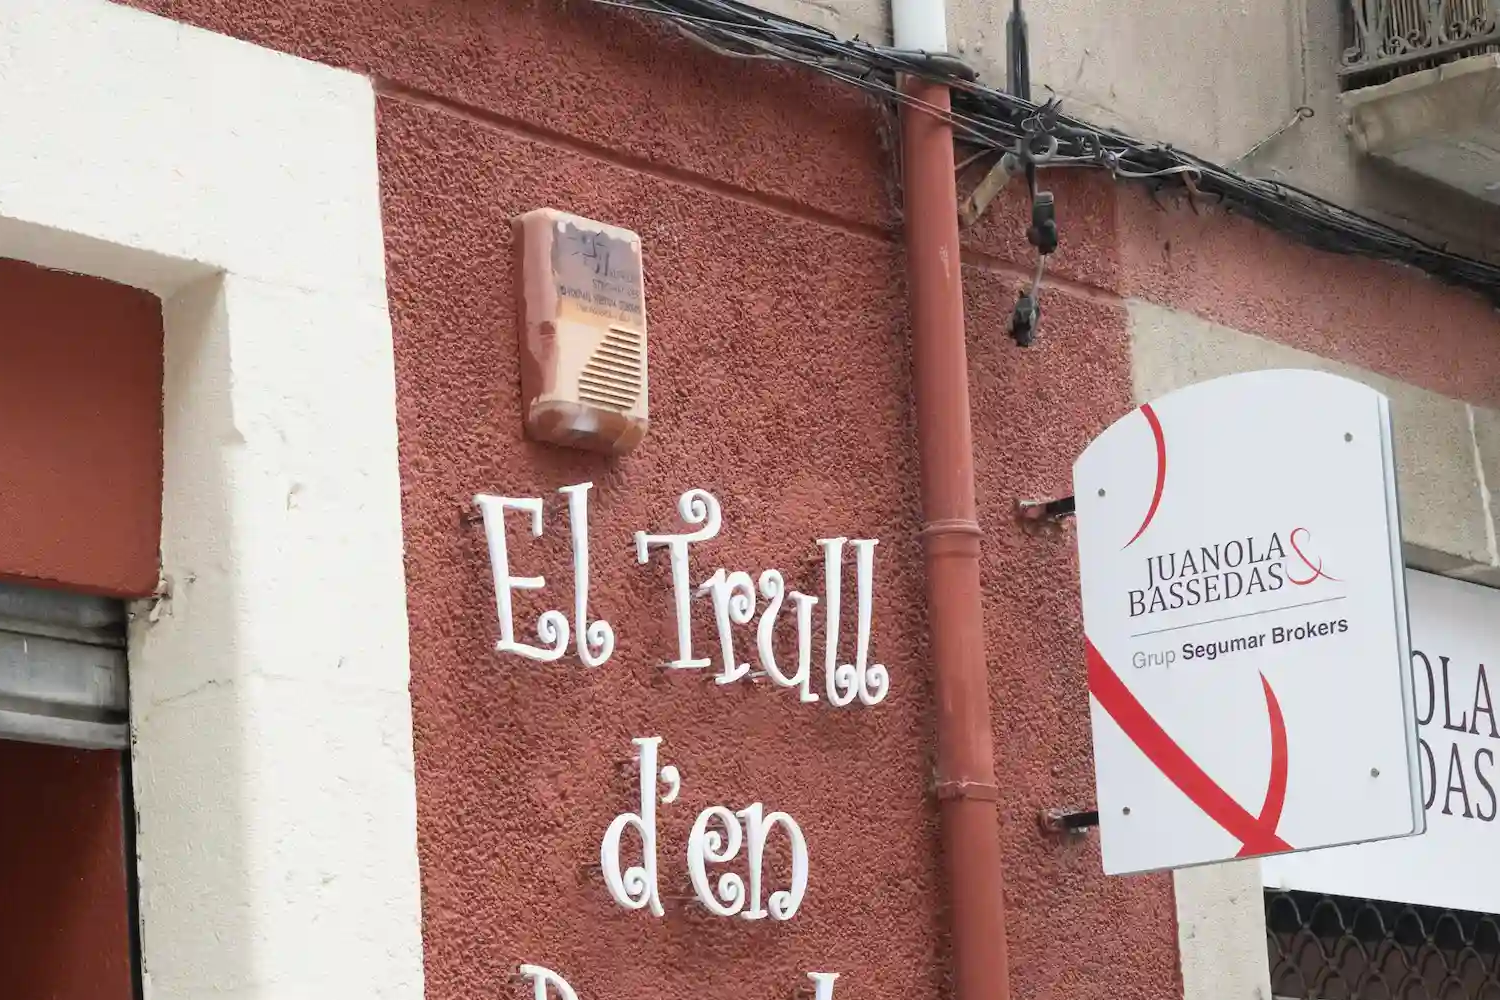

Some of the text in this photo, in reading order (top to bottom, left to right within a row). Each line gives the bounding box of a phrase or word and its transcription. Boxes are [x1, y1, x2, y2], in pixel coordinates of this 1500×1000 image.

[1128, 562, 1285, 618] BASSEDAS
[1147, 531, 1288, 591] JUANOLA
[472, 482, 890, 707] El Trull
[1132, 618, 1349, 669] Grup Segumar Brokers
[600, 736, 810, 922] d'en
